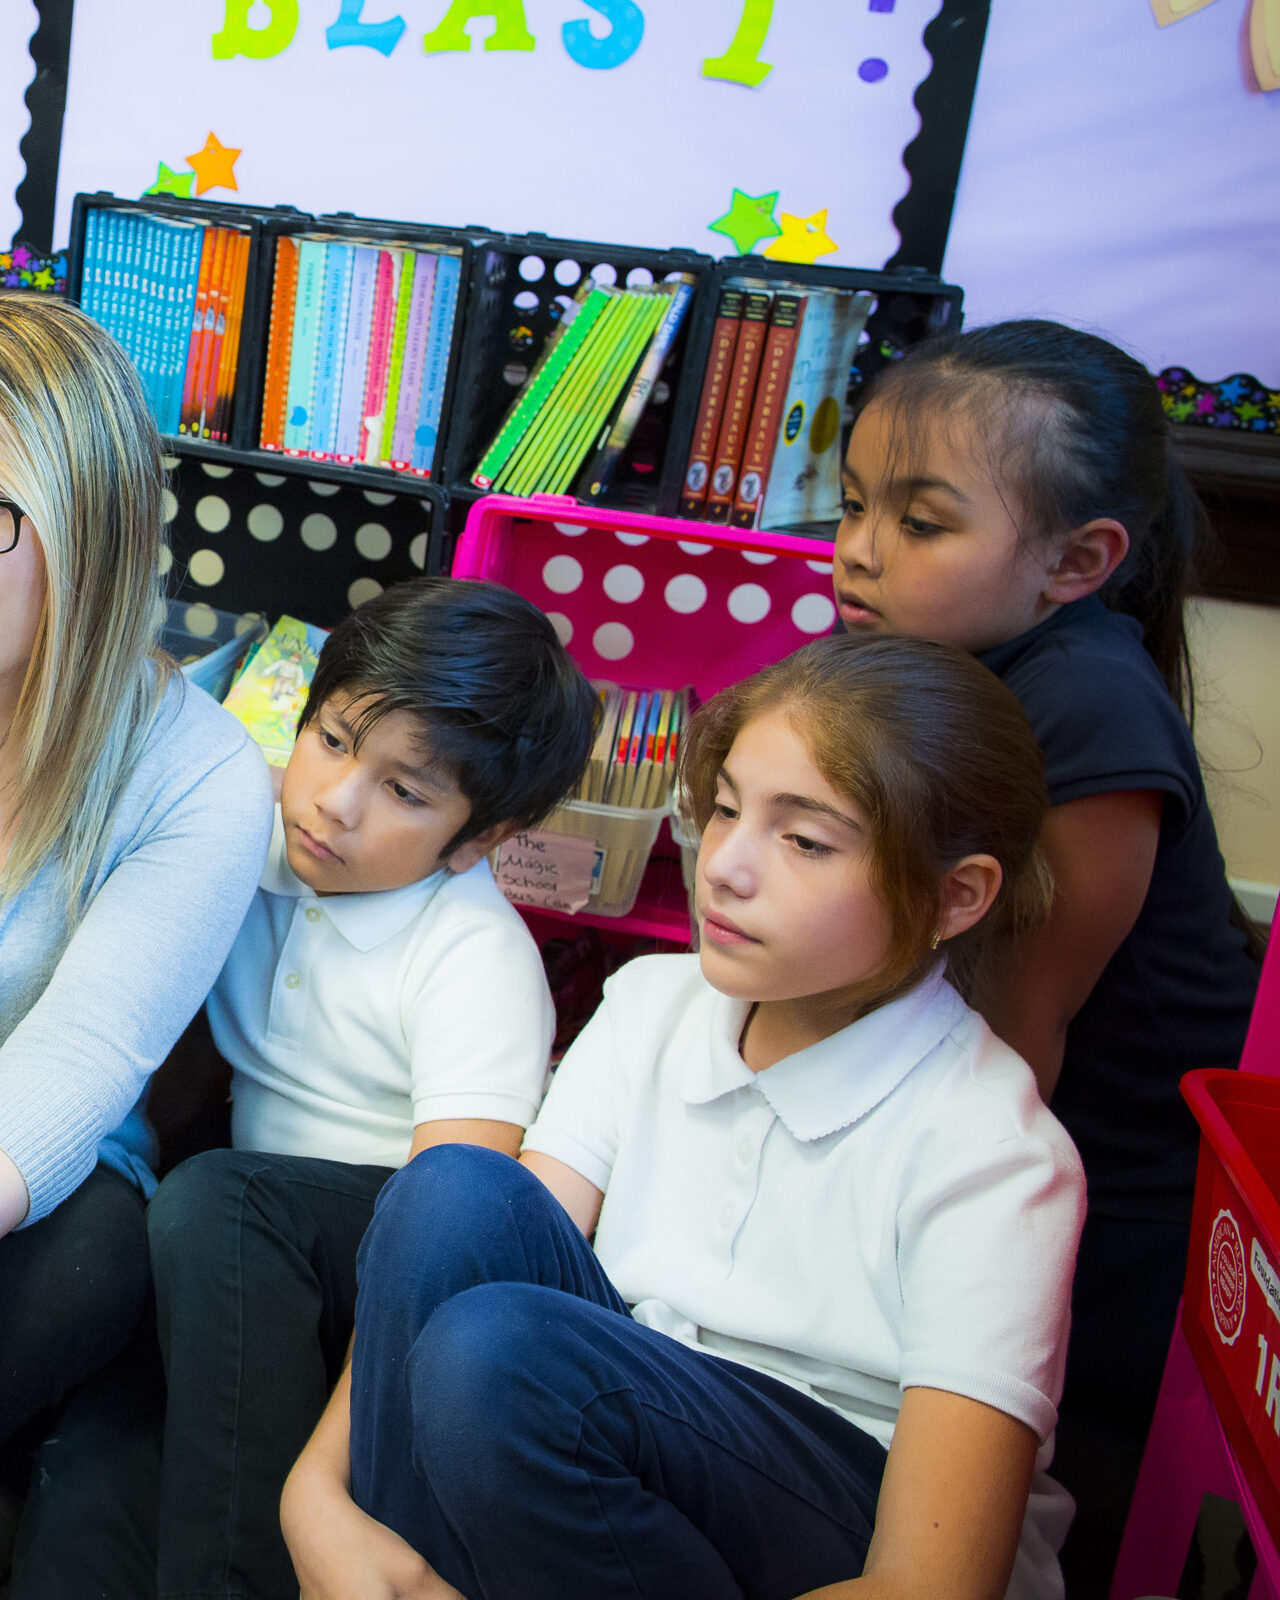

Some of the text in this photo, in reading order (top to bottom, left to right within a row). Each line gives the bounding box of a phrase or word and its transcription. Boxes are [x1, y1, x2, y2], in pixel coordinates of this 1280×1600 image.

[502, 854, 558, 875] Magic
[514, 834, 546, 852] The
[1212, 1222, 1232, 1271] AMERICAN
[1233, 1240, 1243, 1316] READING
[1212, 1283, 1234, 1331] COMPANY
